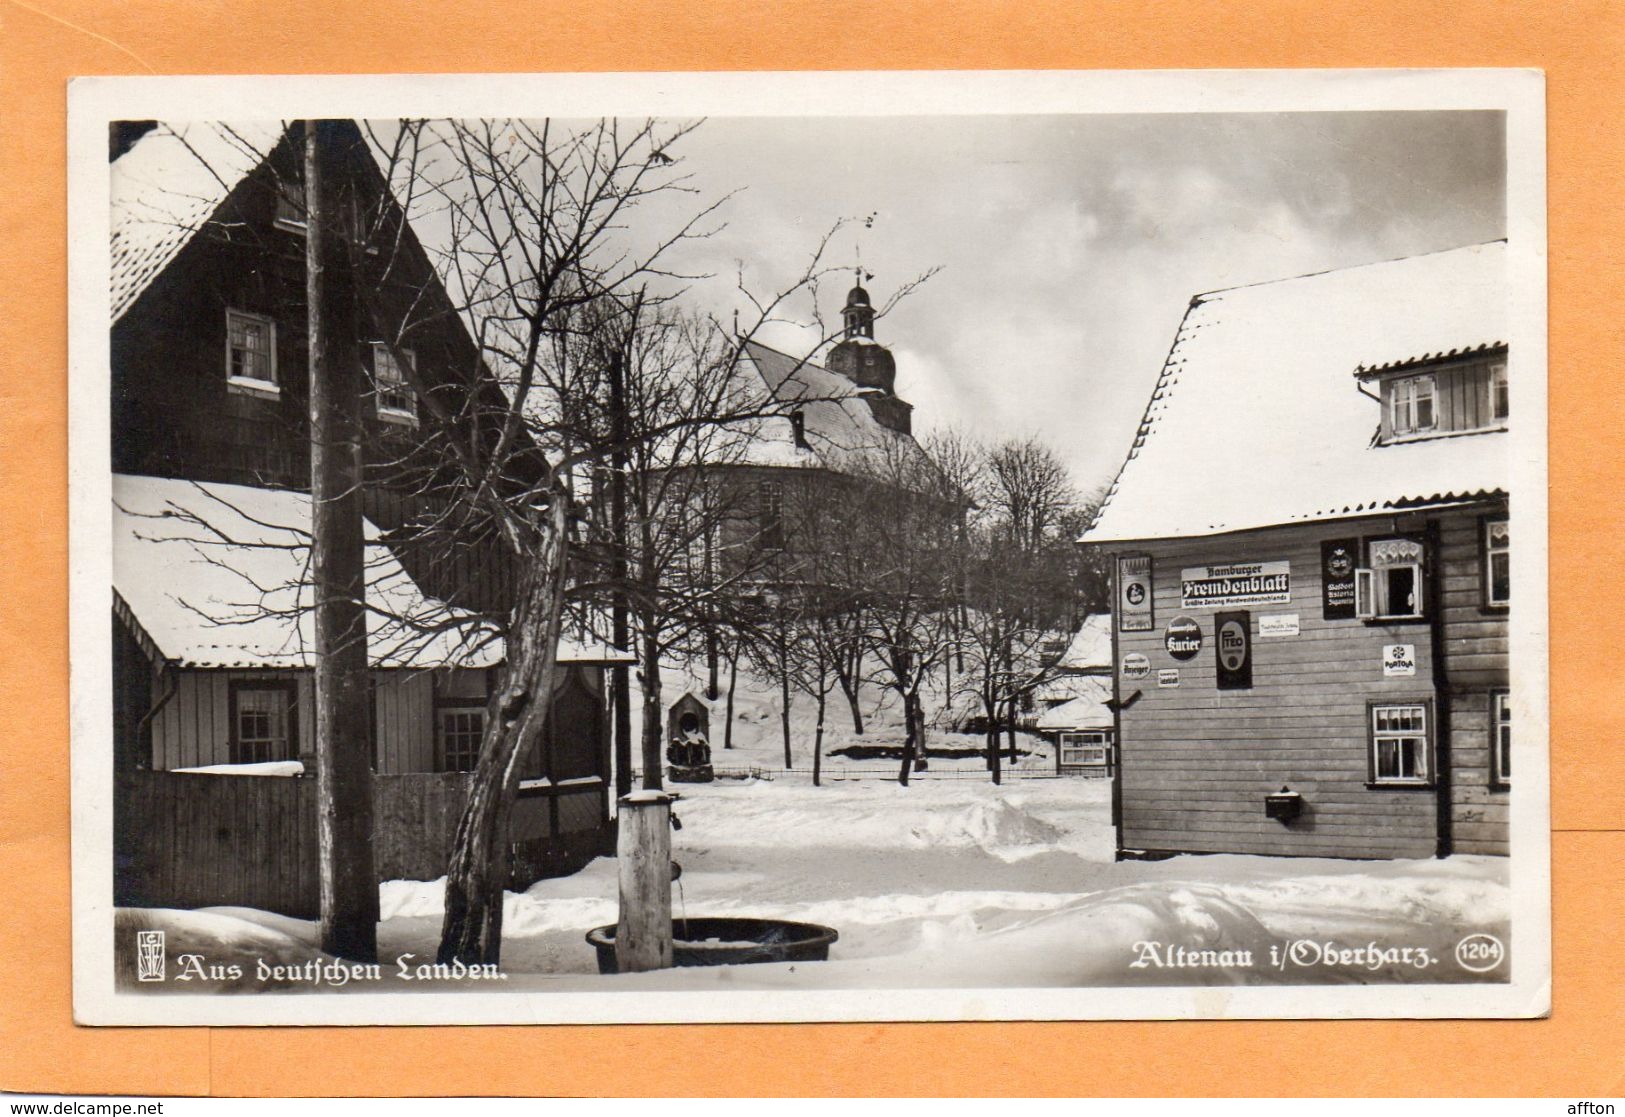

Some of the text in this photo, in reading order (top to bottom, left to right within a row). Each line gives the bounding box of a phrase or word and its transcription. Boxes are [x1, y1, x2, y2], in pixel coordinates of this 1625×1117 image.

[1206, 565, 1263, 578] Hamburger
[1183, 574, 1288, 598] Fremdenblatt
[1167, 636, 1201, 652] Kurier
